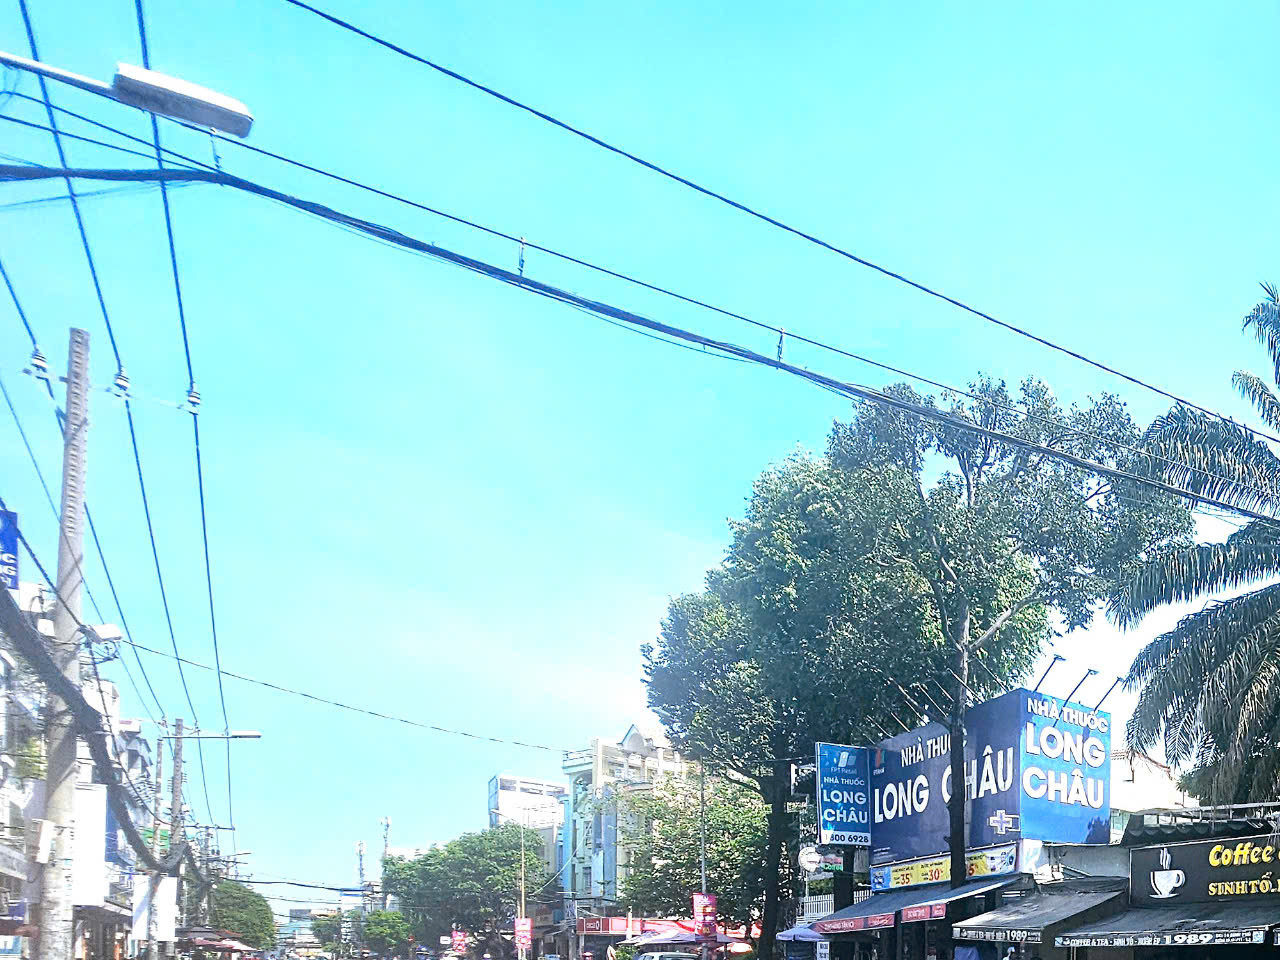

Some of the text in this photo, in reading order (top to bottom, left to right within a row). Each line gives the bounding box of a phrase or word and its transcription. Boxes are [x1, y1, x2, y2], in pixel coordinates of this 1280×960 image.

[1027, 697, 1109, 733] NHÀ THUỐC
[901, 736, 925, 768] NHÀ
[1025, 722, 1106, 768] LONG
[823, 776, 865, 786] NHÀ THUỐC
[1022, 766, 1104, 809] CHÂU
[823, 789, 867, 805] LONG
[874, 774, 930, 824] LONG
[823, 807, 868, 824] CHÂU
[848, 834, 869, 843] 6928
[1209, 843, 1273, 868] Coffee
[1208, 881, 1248, 896] SINH
[1006, 930, 1028, 941] 1989
[1163, 933, 1213, 945] 1989
